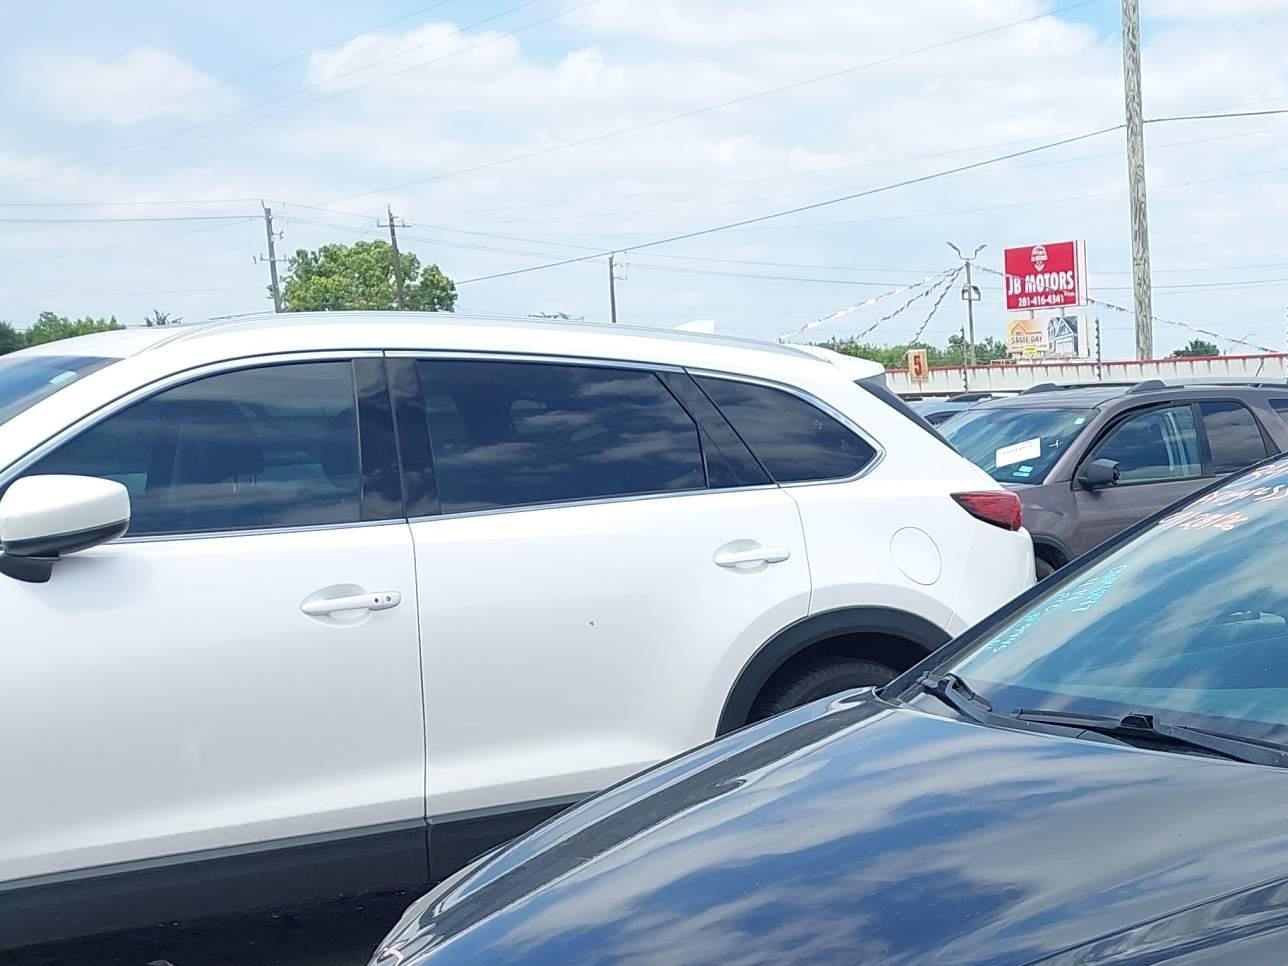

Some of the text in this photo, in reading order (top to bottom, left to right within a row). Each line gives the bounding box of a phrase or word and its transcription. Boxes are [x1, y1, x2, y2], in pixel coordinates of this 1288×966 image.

[1006, 270, 1075, 296] JB MOTORS
[913, 355, 922, 376] 5
